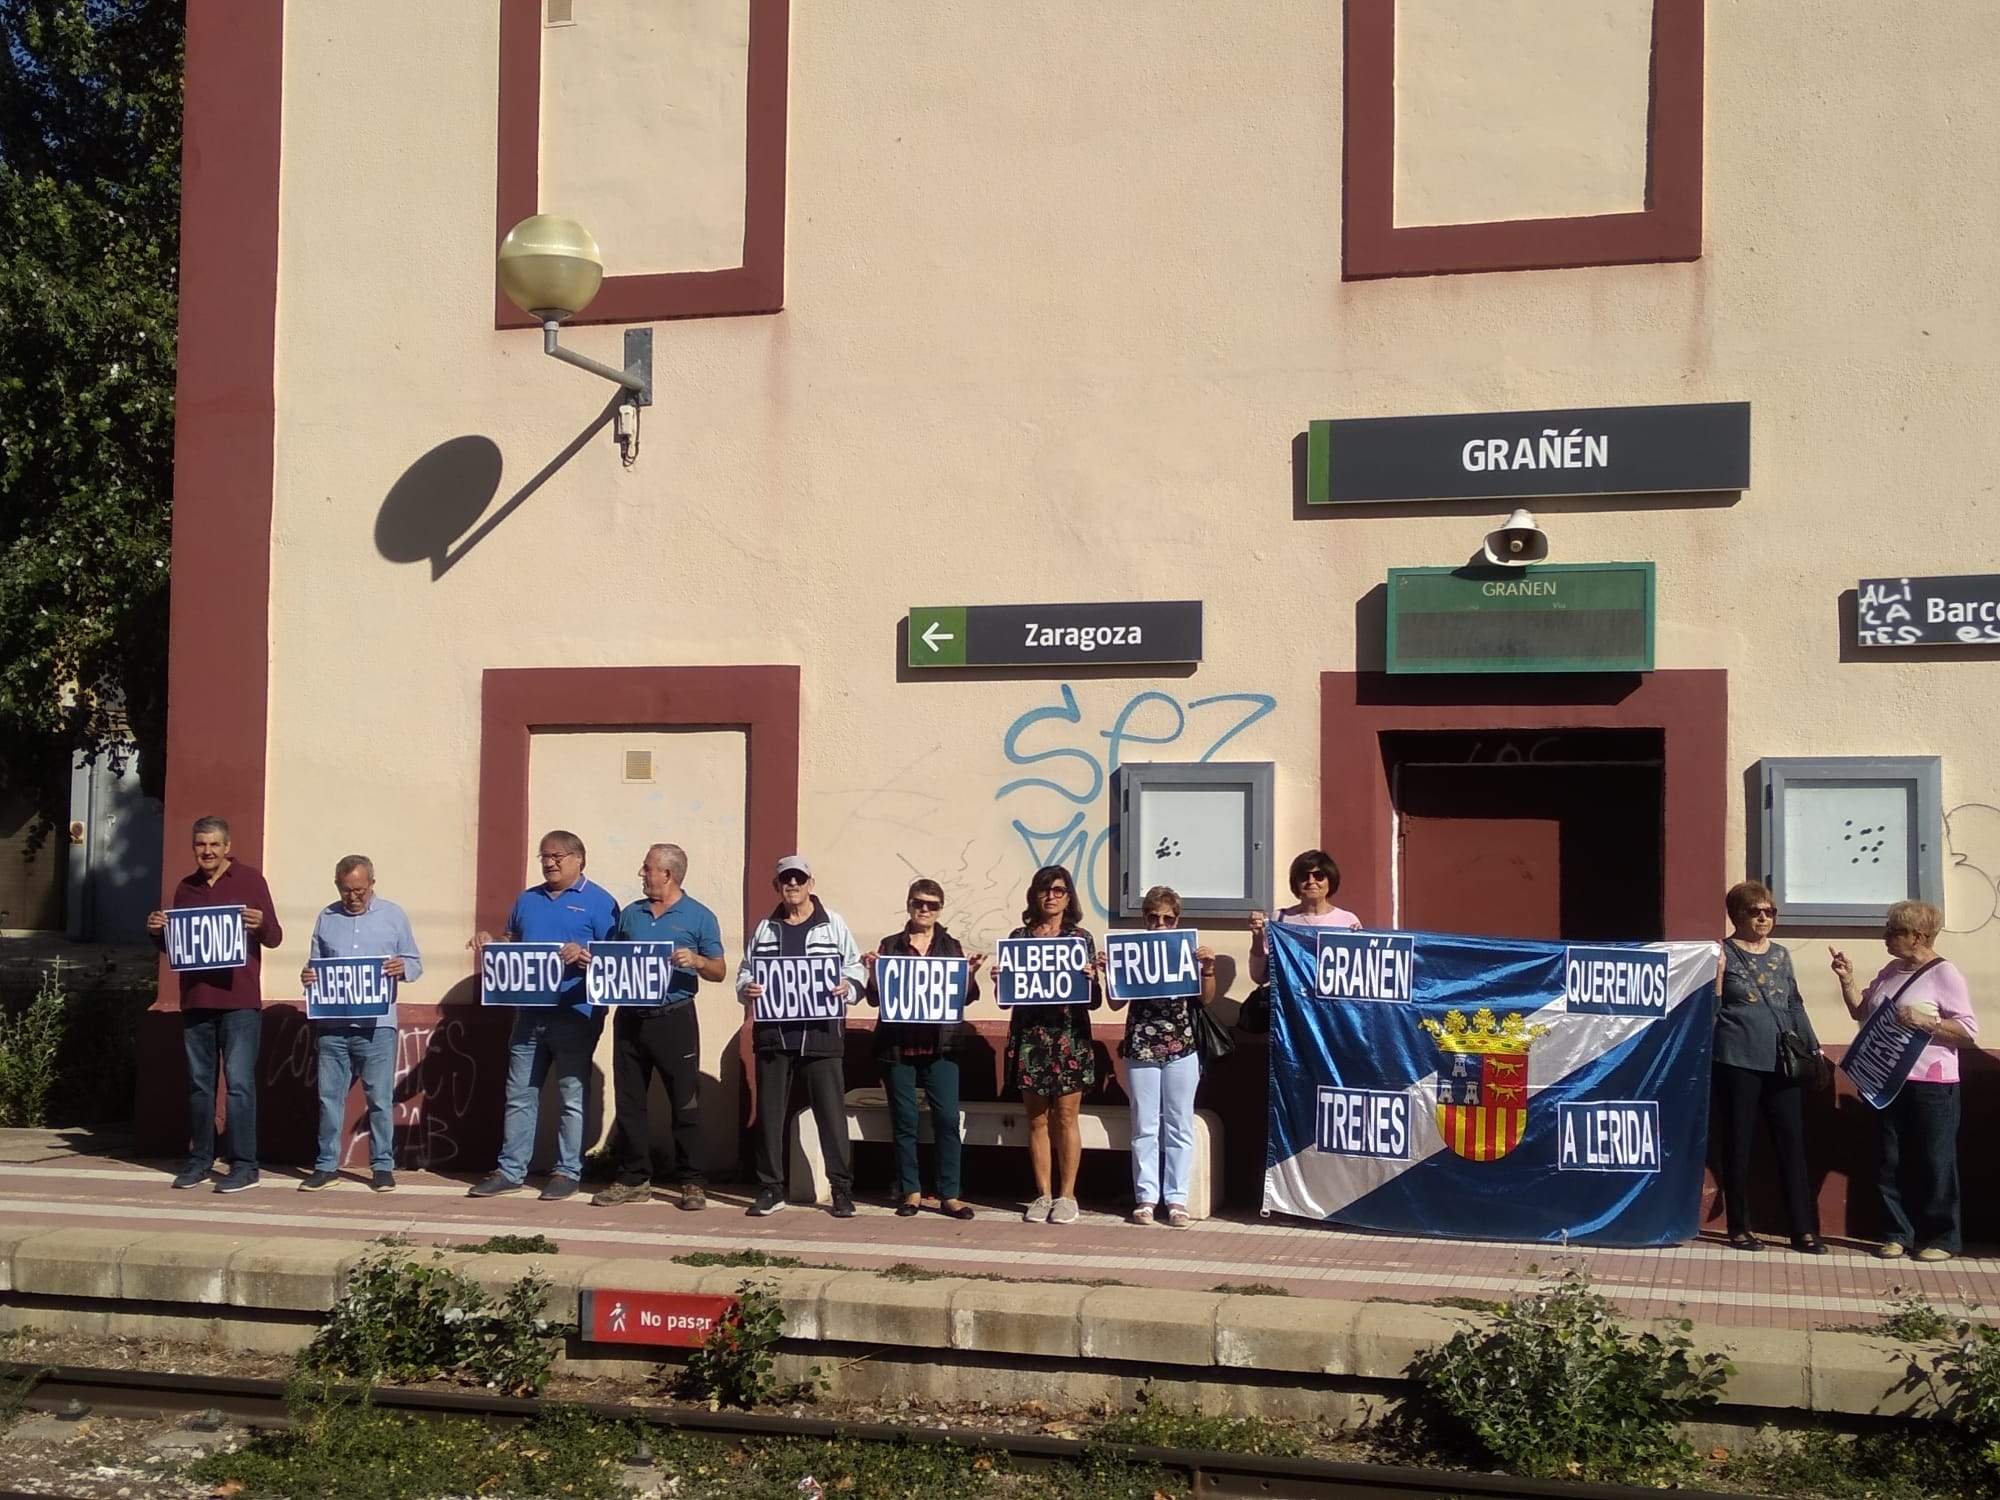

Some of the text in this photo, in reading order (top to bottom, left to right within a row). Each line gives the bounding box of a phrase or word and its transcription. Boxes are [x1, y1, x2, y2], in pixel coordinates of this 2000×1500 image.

[1461, 428, 1609, 472] GRAÑÉN
[1482, 579, 1557, 597] GRAÑEN
[1927, 597, 2000, 623] Barc
[1024, 623, 1142, 651] Zaragoza
[164, 913, 244, 965] VALFONDA
[1000, 944, 1087, 972] ALBERO
[311, 964, 389, 1005] ALBERUELA
[483, 951, 562, 992] SODETO
[588, 944, 672, 1001] GRAÑÉN
[1108, 939, 1198, 986] FRULA
[1319, 938, 1409, 1000] GRAÑÉN
[1567, 960, 1666, 1008] QUEREMOS
[756, 957, 839, 1018] ROBRES
[884, 959, 959, 1020] CURBE
[1014, 972, 1072, 999] BAJO
[1320, 1093, 1405, 1155] TRENES
[1562, 1109, 1656, 1165] A LERIDA
[640, 1311, 661, 1327] No
